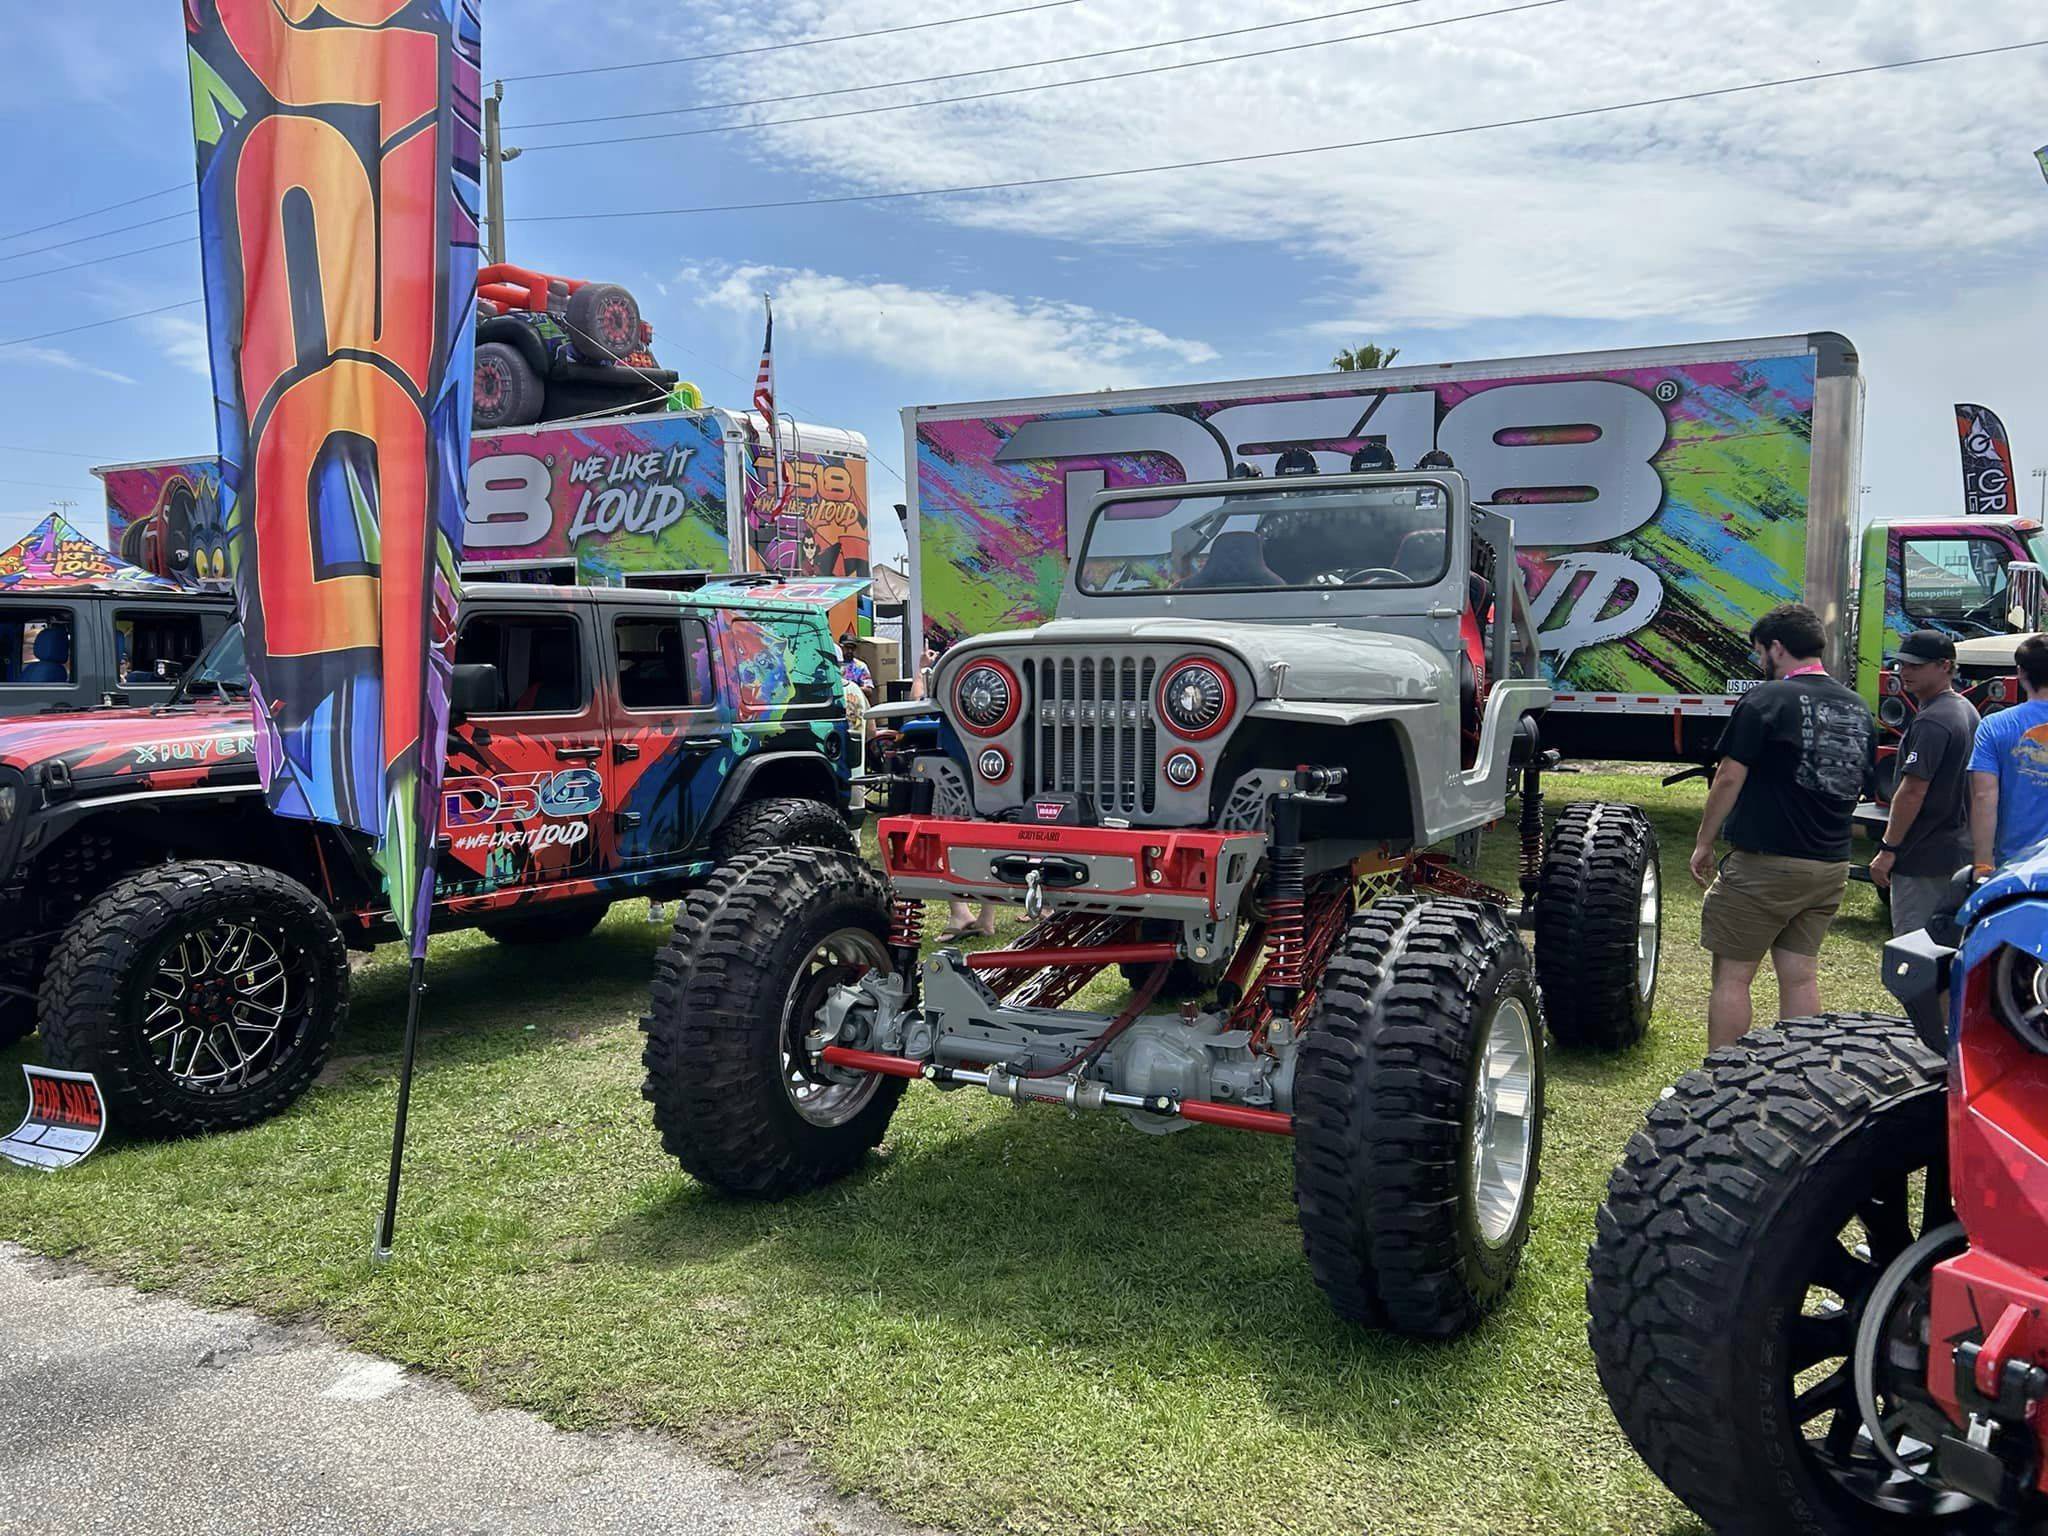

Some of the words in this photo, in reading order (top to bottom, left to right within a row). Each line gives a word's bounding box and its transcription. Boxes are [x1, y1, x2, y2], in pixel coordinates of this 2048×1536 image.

[569, 456, 607, 484] WE
[607, 450, 664, 484] LIKE
[665, 446, 696, 479] IT
[568, 480, 685, 550] LOUD
[46, 552, 86, 562] LIKE
[90, 553, 107, 562] IT
[62, 541, 95, 553] WE
[52, 559, 116, 576] LOUD
[1728, 680, 1740, 692] US
[1741, 680, 1761, 692] DO
[441, 768, 603, 829] DS18
[32, 1078, 60, 1121] FOR
[61, 1081, 101, 1126] SALE
